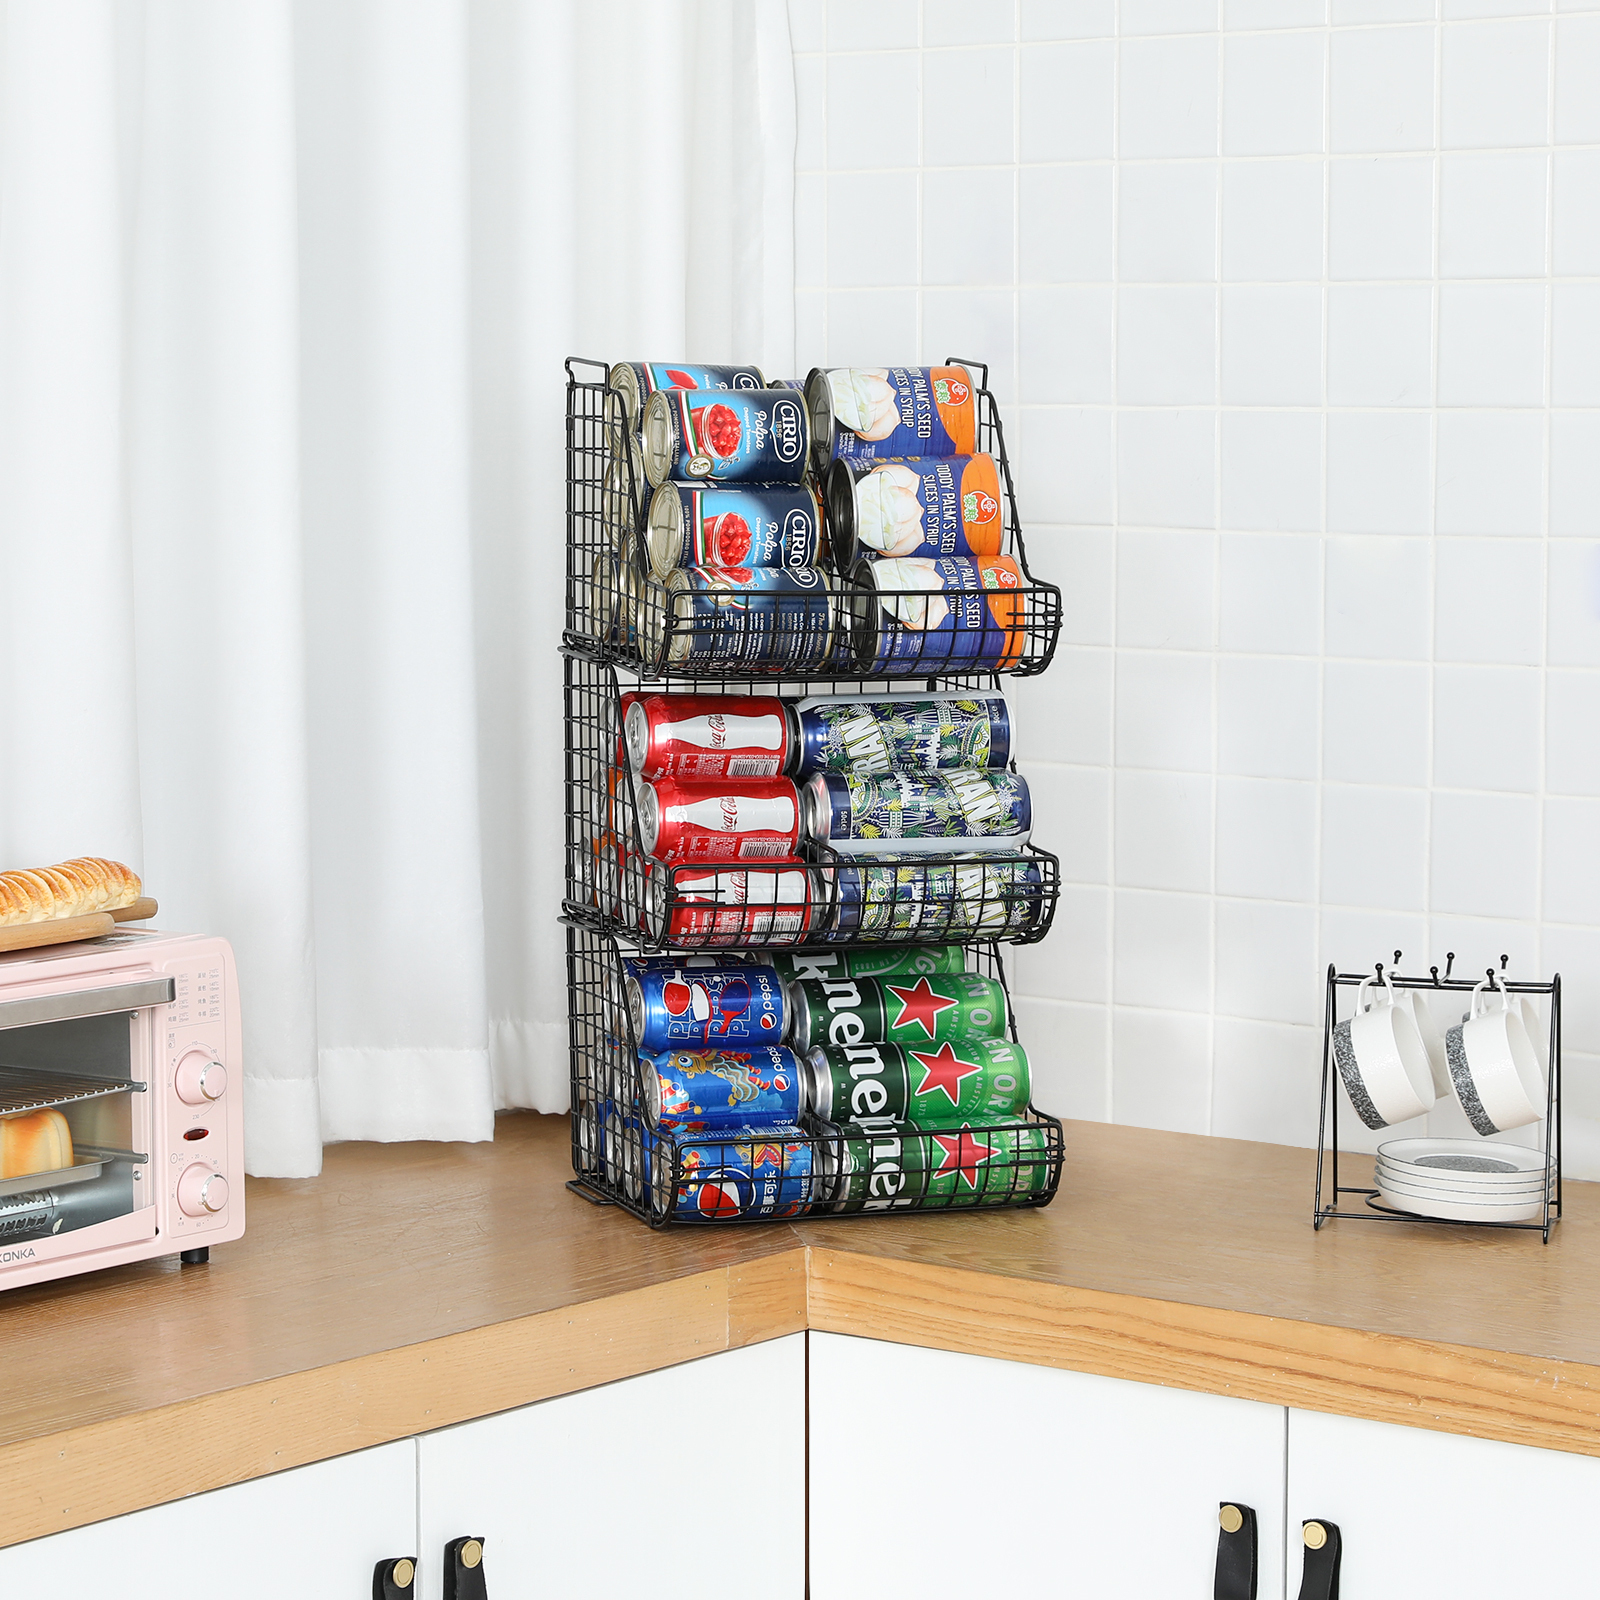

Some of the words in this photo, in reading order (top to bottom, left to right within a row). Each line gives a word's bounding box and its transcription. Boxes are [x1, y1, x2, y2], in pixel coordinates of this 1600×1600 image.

[899, 387, 912, 396] IN
[912, 379, 931, 410] PALM'S
[900, 398, 915, 428] SYRUP
[917, 413, 932, 438] SEED
[753, 410, 768, 450] Polpa
[779, 404, 798, 457] CIRIO
[922, 475, 939, 502] SLICES
[936, 464, 955, 490] TODDY
[927, 504, 939, 515] IN
[942, 493, 957, 530] PALM'S
[763, 521, 779, 562] Polpa
[784, 532, 793, 551] 1856
[789, 515, 806, 567] CIRIO
[926, 517, 940, 546] SYRUP
[940, 532, 956, 553] SEED
[947, 577, 960, 585] IN
[960, 568, 979, 600] PALMS
[966, 602, 981, 628] SEED
[755, 975, 775, 1011] pepsi
[917, 1099, 928, 1117] 1873
[935, 1182, 946, 1194] 187
